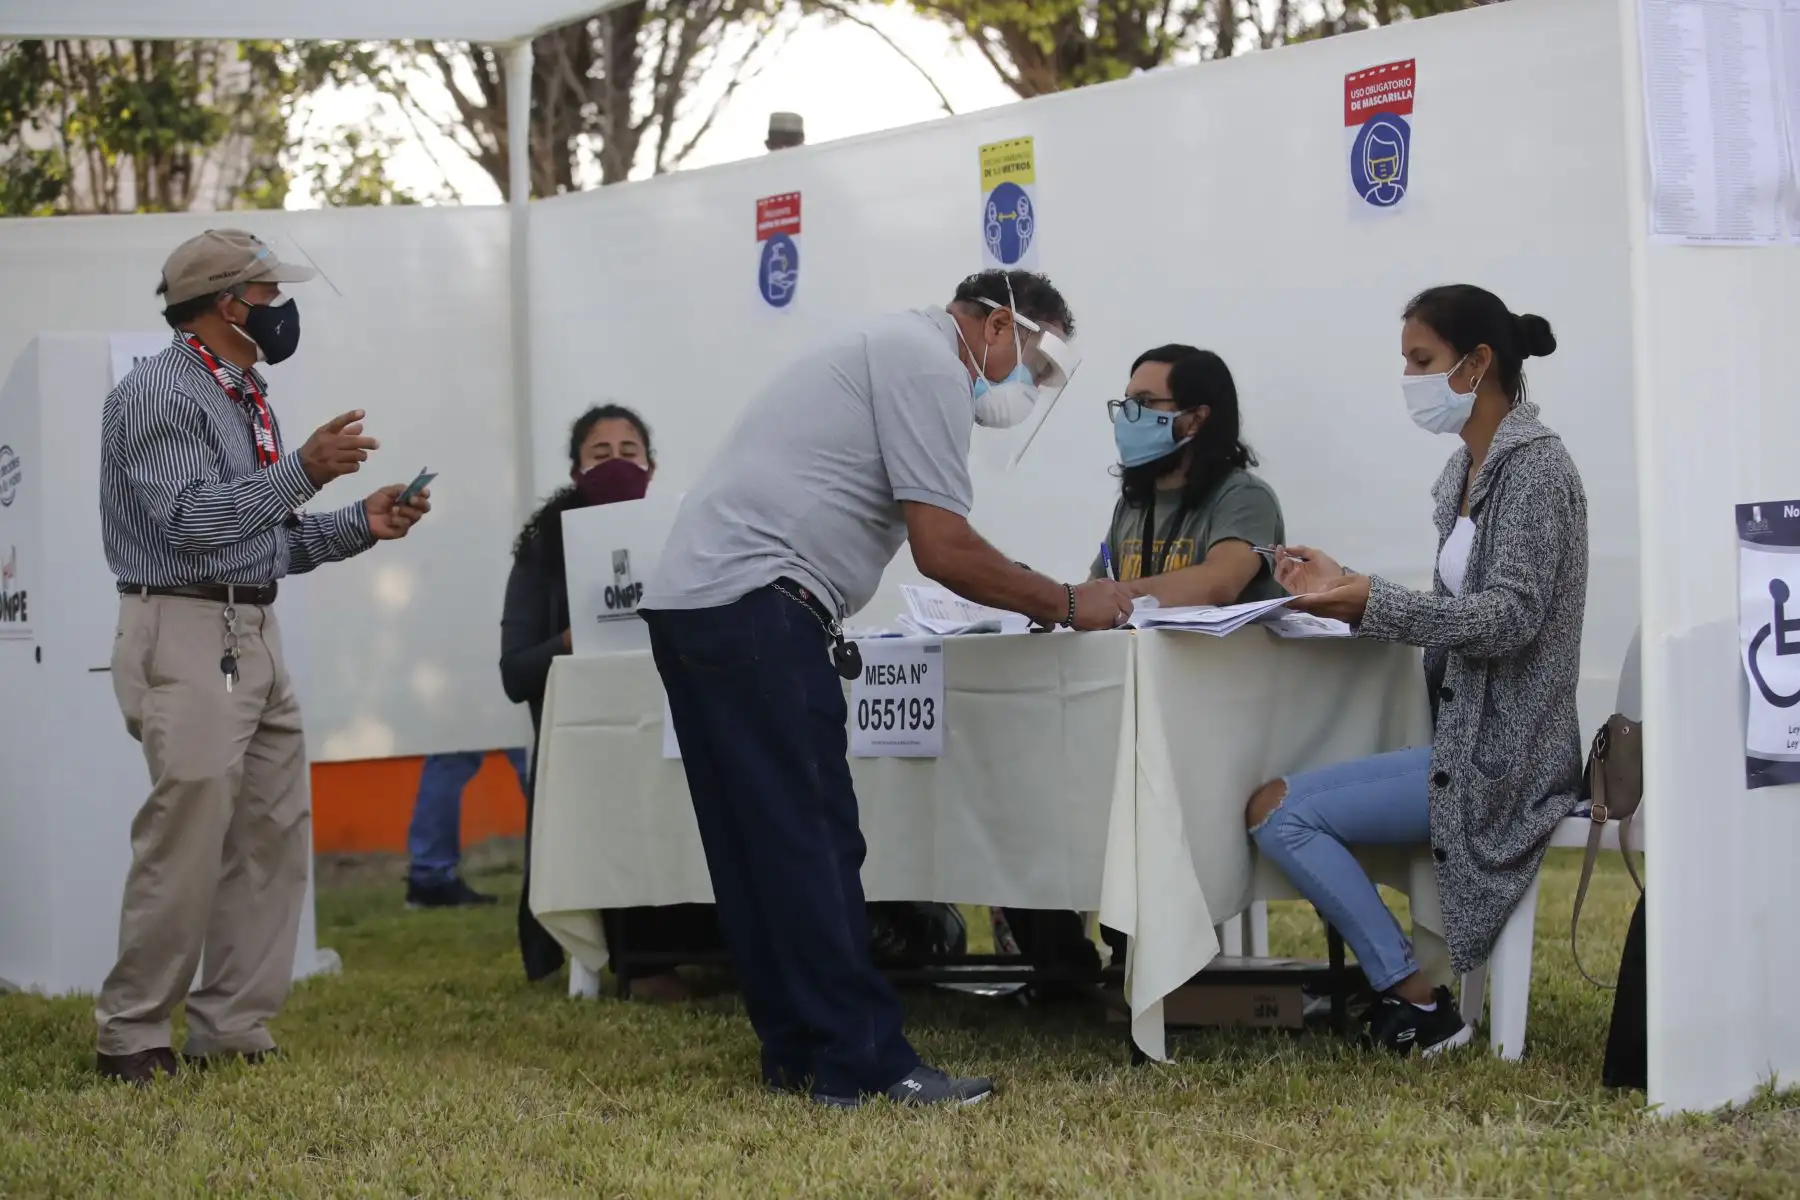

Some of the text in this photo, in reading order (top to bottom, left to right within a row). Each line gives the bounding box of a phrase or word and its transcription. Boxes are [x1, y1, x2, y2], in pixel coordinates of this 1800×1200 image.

[1350, 78, 1412, 99] USO OBLIGATORIO
[1351, 89, 1413, 111] DE MASCARILLA
[1002, 161, 1031, 174] METROS
[214, 367, 237, 390] NIKE
[262, 429, 276, 452] NIKE
[0, 591, 27, 622] NPE
[865, 663, 928, 685] MESA Nº
[858, 697, 935, 731] 055193
[1786, 740, 1799, 750] Ley
